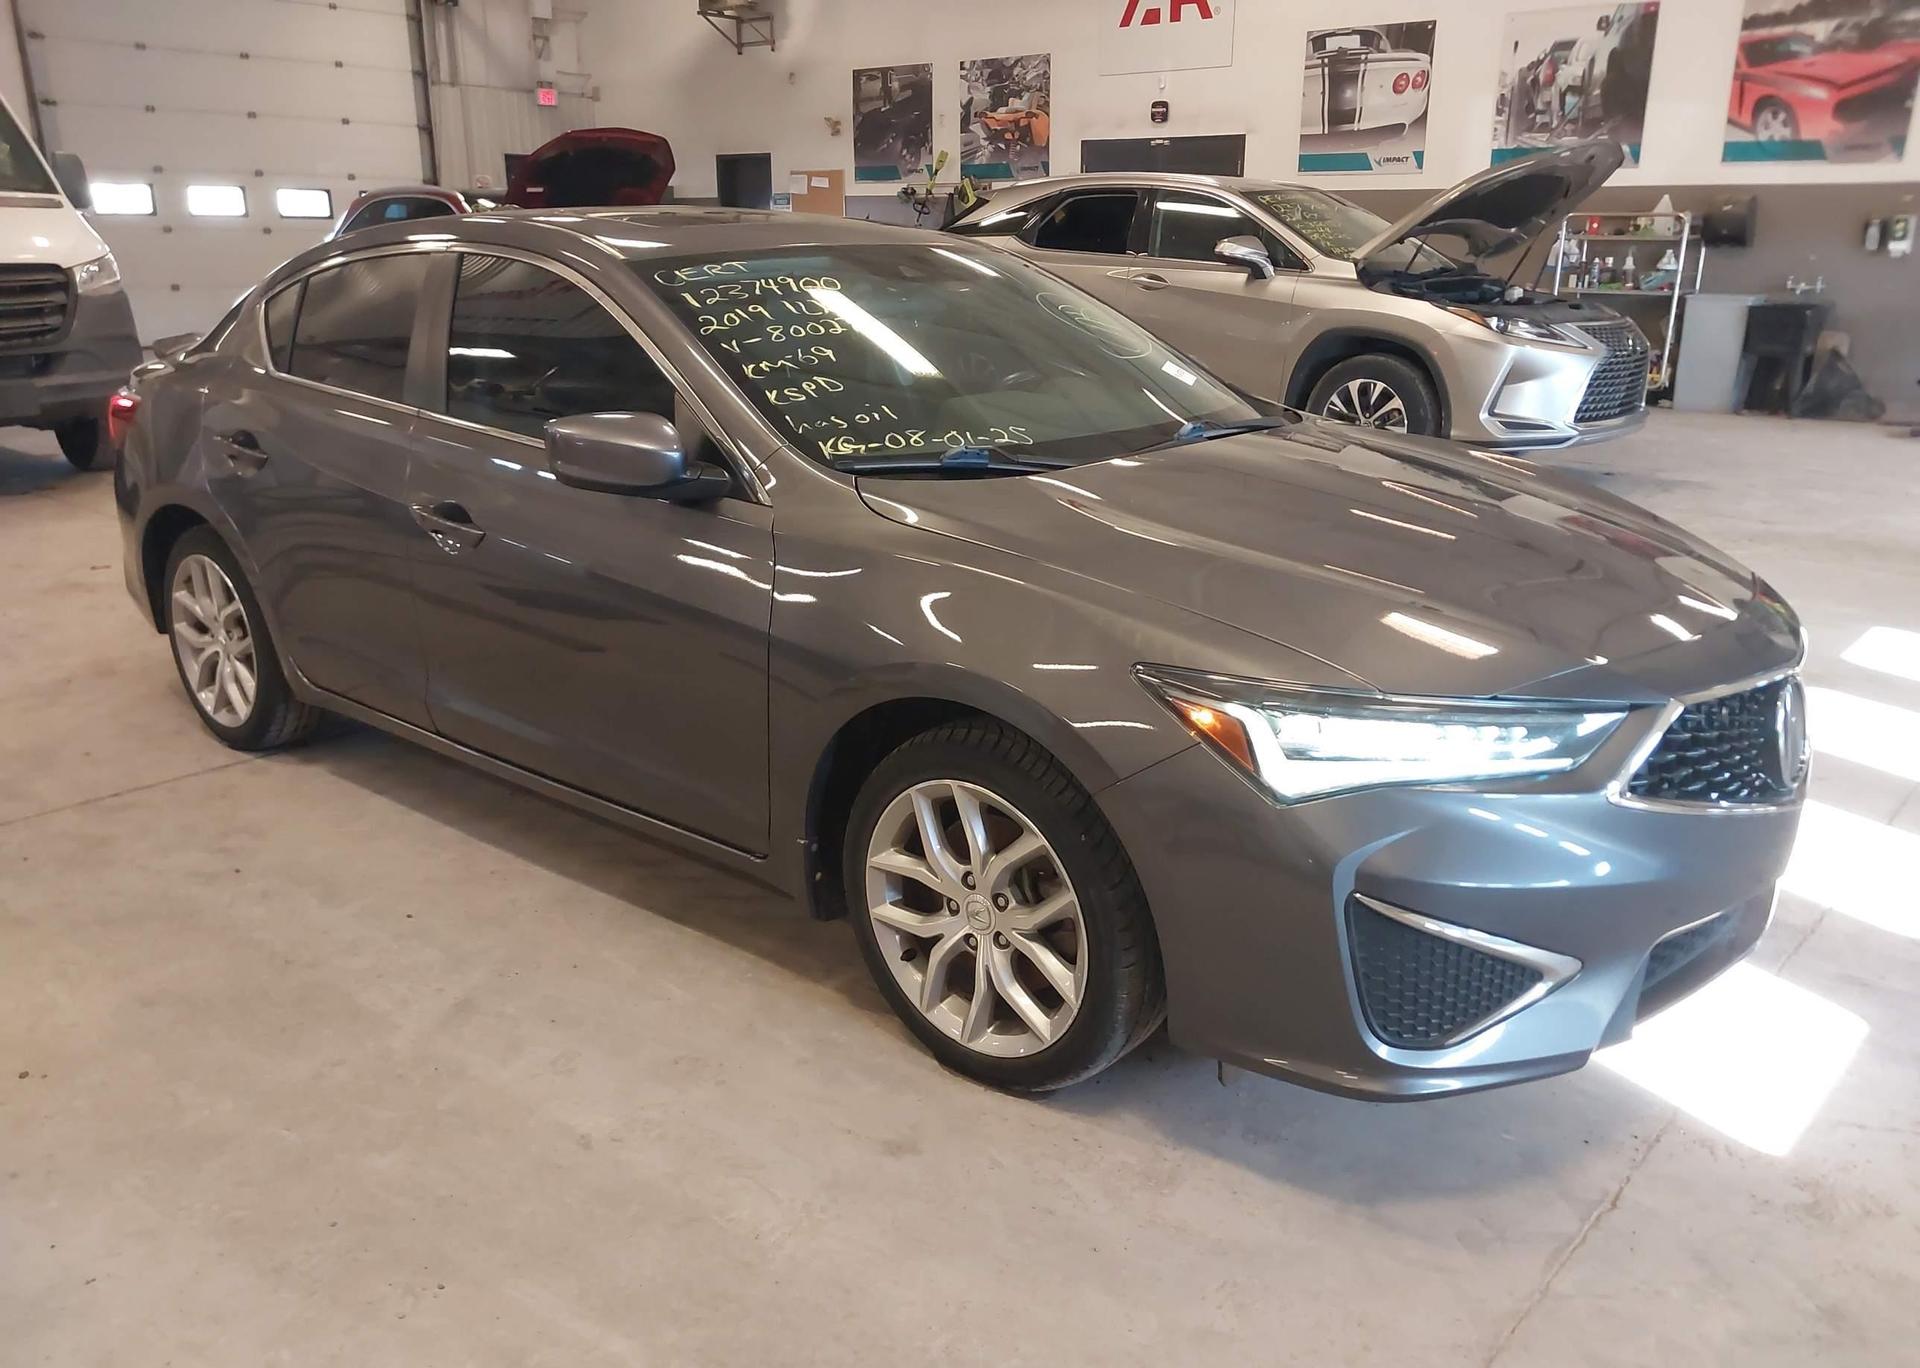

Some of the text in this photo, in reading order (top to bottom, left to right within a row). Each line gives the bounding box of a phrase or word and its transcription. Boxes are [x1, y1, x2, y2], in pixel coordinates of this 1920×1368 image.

[654, 261, 750, 286] CERT
[680, 276, 842, 308] 12374900
[698, 304, 775, 336] 2019
